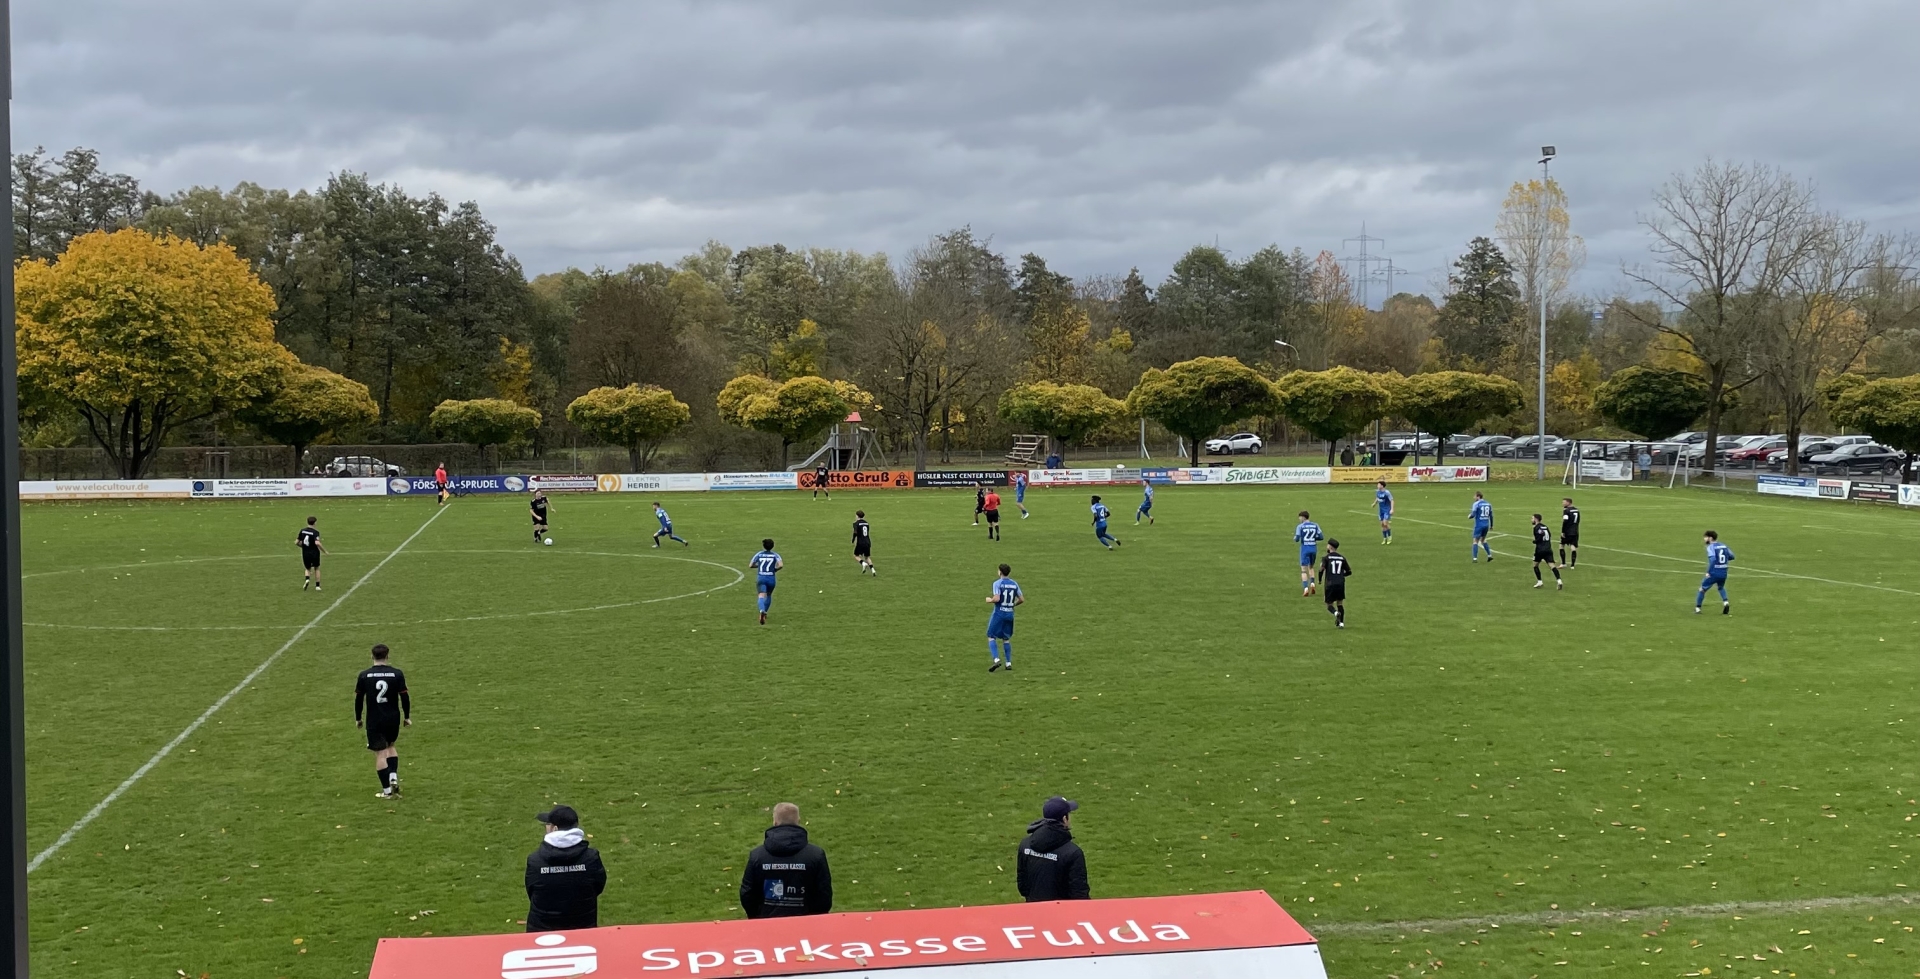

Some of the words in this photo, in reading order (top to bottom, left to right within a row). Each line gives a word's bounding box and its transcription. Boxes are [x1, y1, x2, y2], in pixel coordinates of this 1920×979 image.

[854, 472, 890, 482] Gruß
[1226, 469, 1279, 482] STÜBIGER
[55, 482, 149, 492] www.velocultour.de
[413, 479, 499, 490] FÖRSTA-SPRUDEL
[1480, 505, 1490, 517] 18
[1573, 512, 1579, 524] 7
[862, 525, 868, 537] 8
[1303, 528, 1317, 542] 22
[1718, 548, 1726, 564] 6
[758, 557, 775, 572] 77
[1330, 560, 1343, 575] 17
[1001, 589, 1015, 607] 11
[375, 679, 389, 704] 2
[790, 863, 807, 871] KASSEL
[641, 936, 987, 974] Sparkasse
[1002, 919, 1191, 949] Fulda
